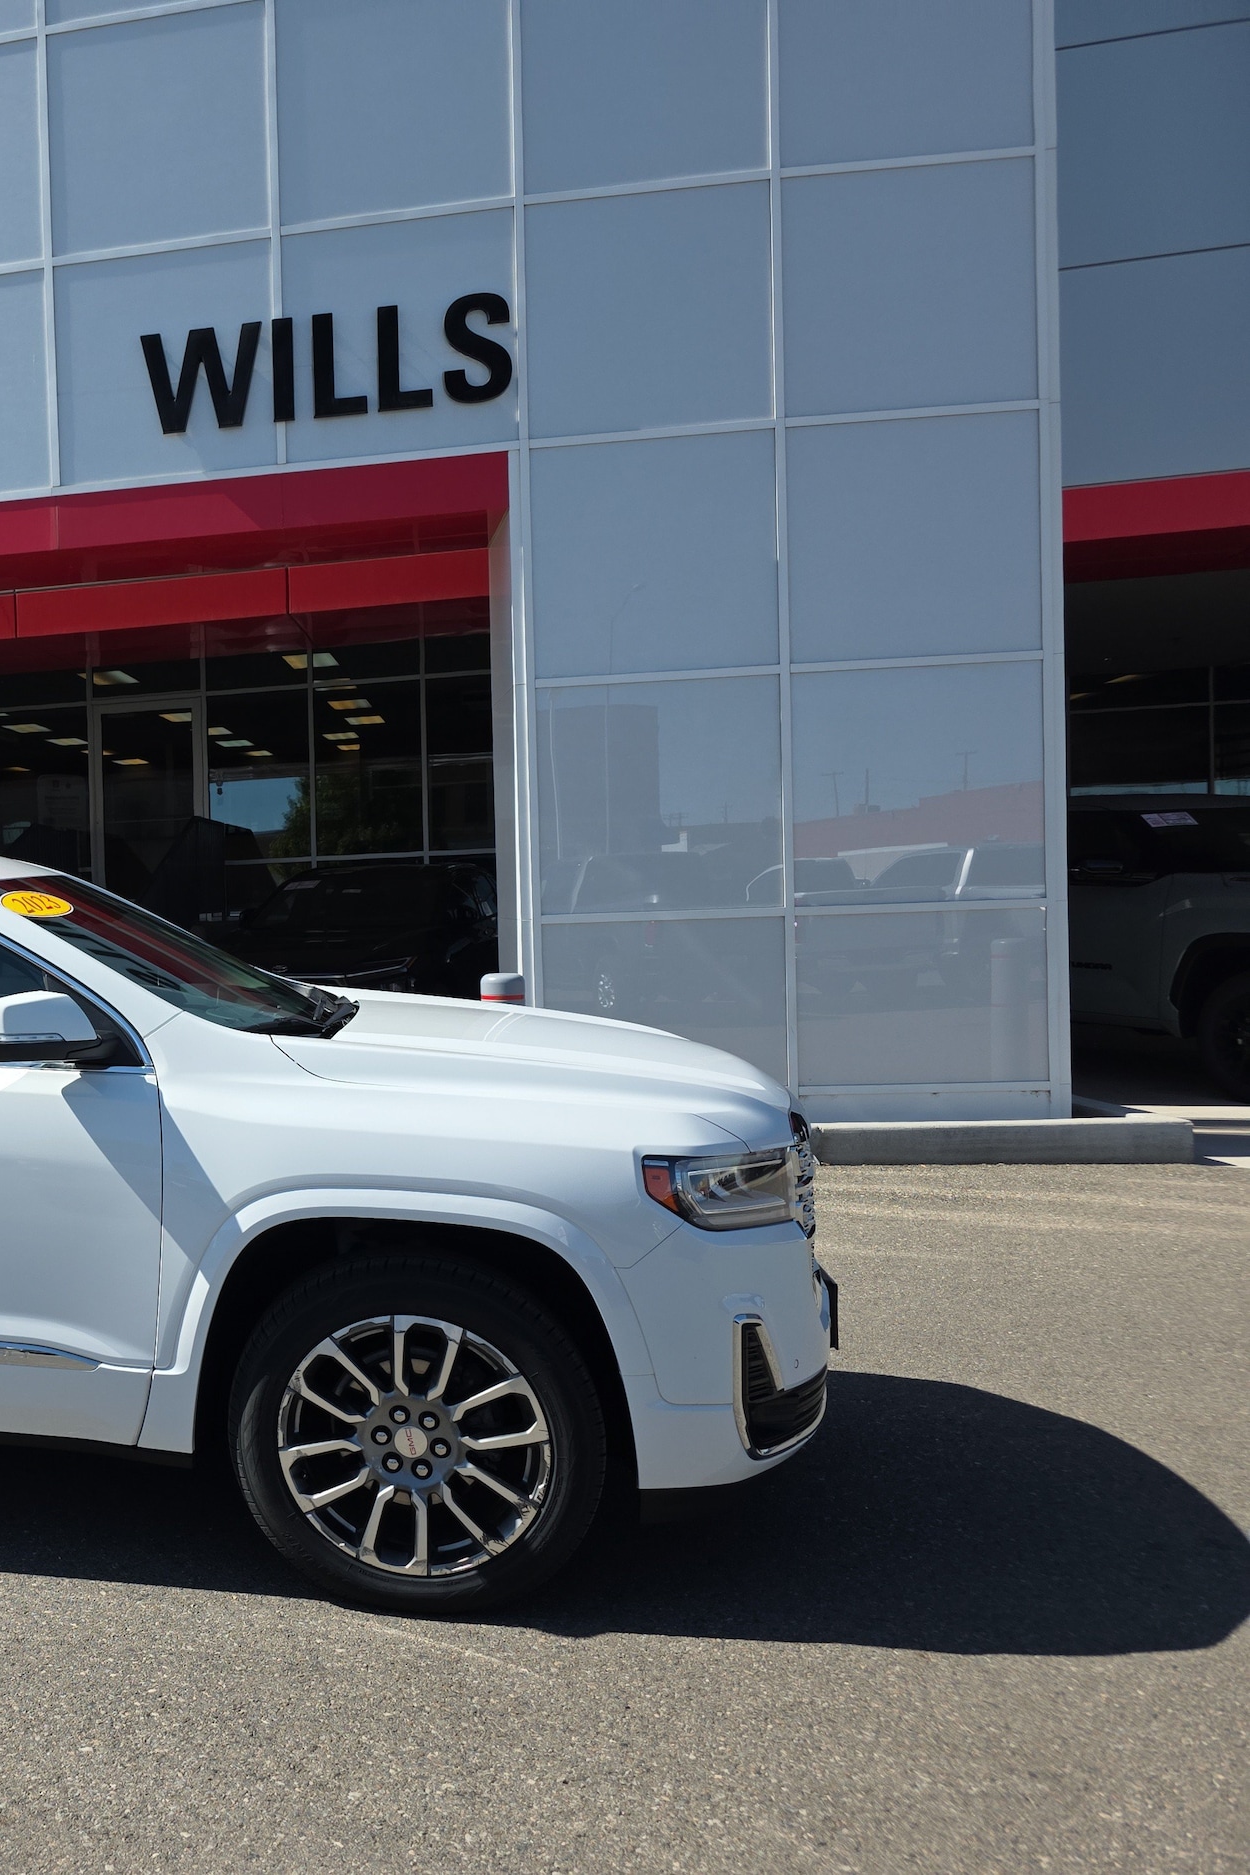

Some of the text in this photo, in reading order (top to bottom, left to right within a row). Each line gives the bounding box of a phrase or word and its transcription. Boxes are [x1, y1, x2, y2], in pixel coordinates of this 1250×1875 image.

[139, 292, 513, 435] WILLS
[11, 894, 61, 914] 2023
[1071, 960, 1113, 971] UNDRA
[405, 1428, 417, 1456] GMC
